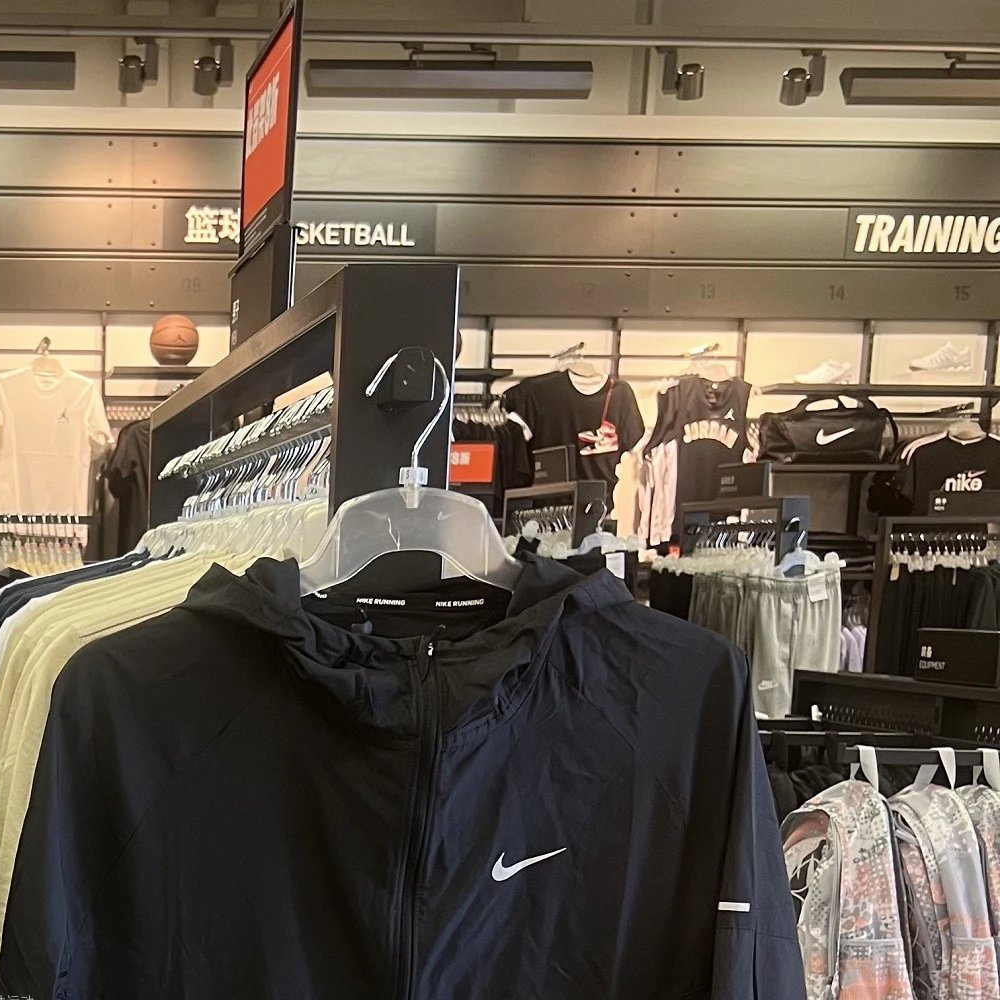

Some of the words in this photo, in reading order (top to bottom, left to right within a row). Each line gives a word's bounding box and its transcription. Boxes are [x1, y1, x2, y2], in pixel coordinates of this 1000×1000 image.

[296, 221, 415, 247] SKETBALL
[853, 214, 1000, 254] TRAINING
[699, 284, 716, 299] 13
[828, 285, 845, 300] 14
[954, 285, 971, 301] 15
[944, 473, 983, 492] nike
[374, 598, 406, 606] RUNNING
[452, 598, 484, 607] RUNNING
